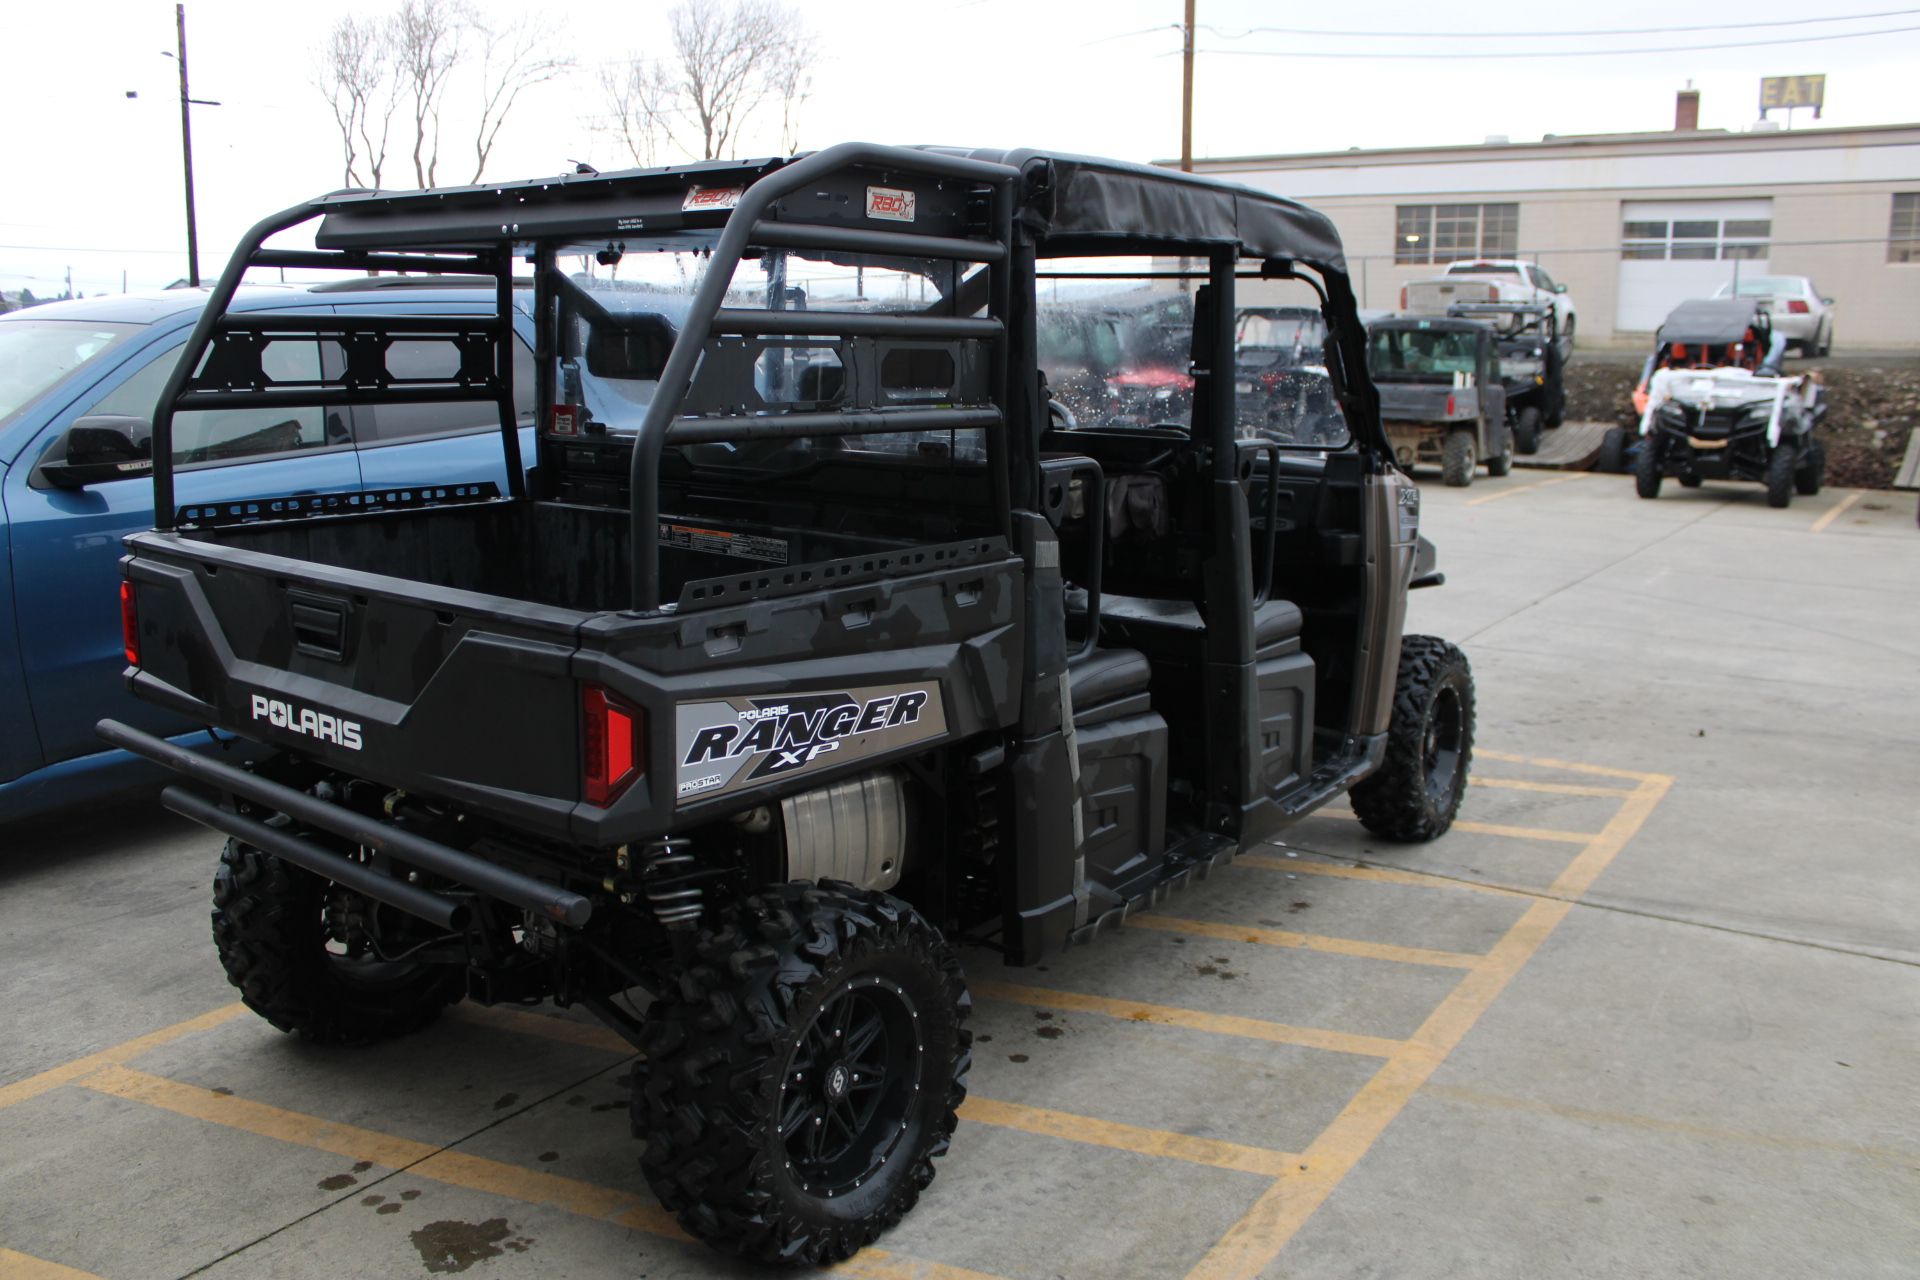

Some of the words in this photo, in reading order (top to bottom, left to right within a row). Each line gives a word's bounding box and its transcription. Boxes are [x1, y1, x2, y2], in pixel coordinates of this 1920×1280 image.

[1763, 77, 1824, 104] EAT
[251, 694, 362, 751] POLARIS
[738, 704, 789, 721] POLARIS
[681, 690, 928, 768] RANGER
[770, 740, 840, 769] XP
[679, 774, 721, 792] PROSTAR
